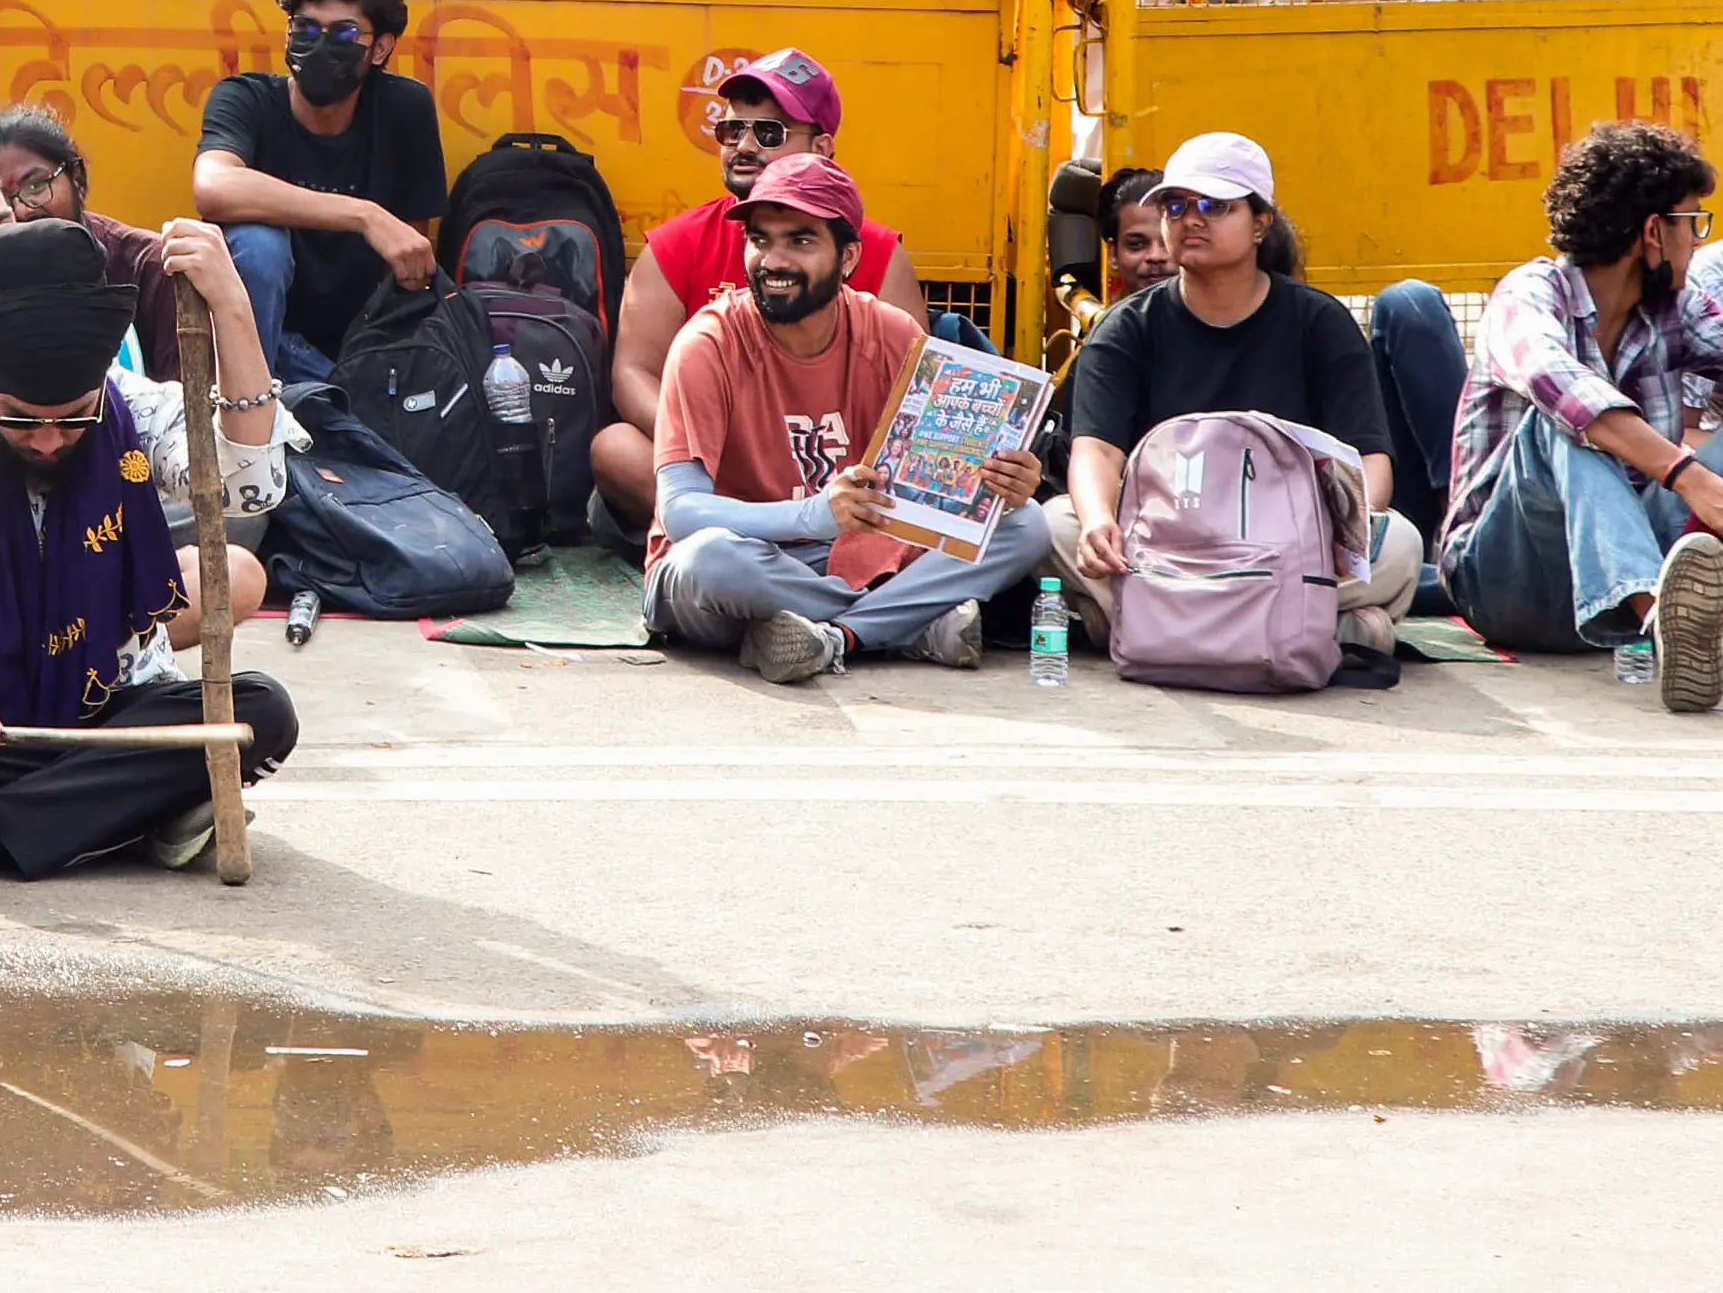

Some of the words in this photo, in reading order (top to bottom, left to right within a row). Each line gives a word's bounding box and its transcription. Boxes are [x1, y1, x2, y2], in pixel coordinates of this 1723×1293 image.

[533, 382, 577, 396] adidas
[948, 377, 978, 396] हम
[978, 377, 1002, 400] भी
